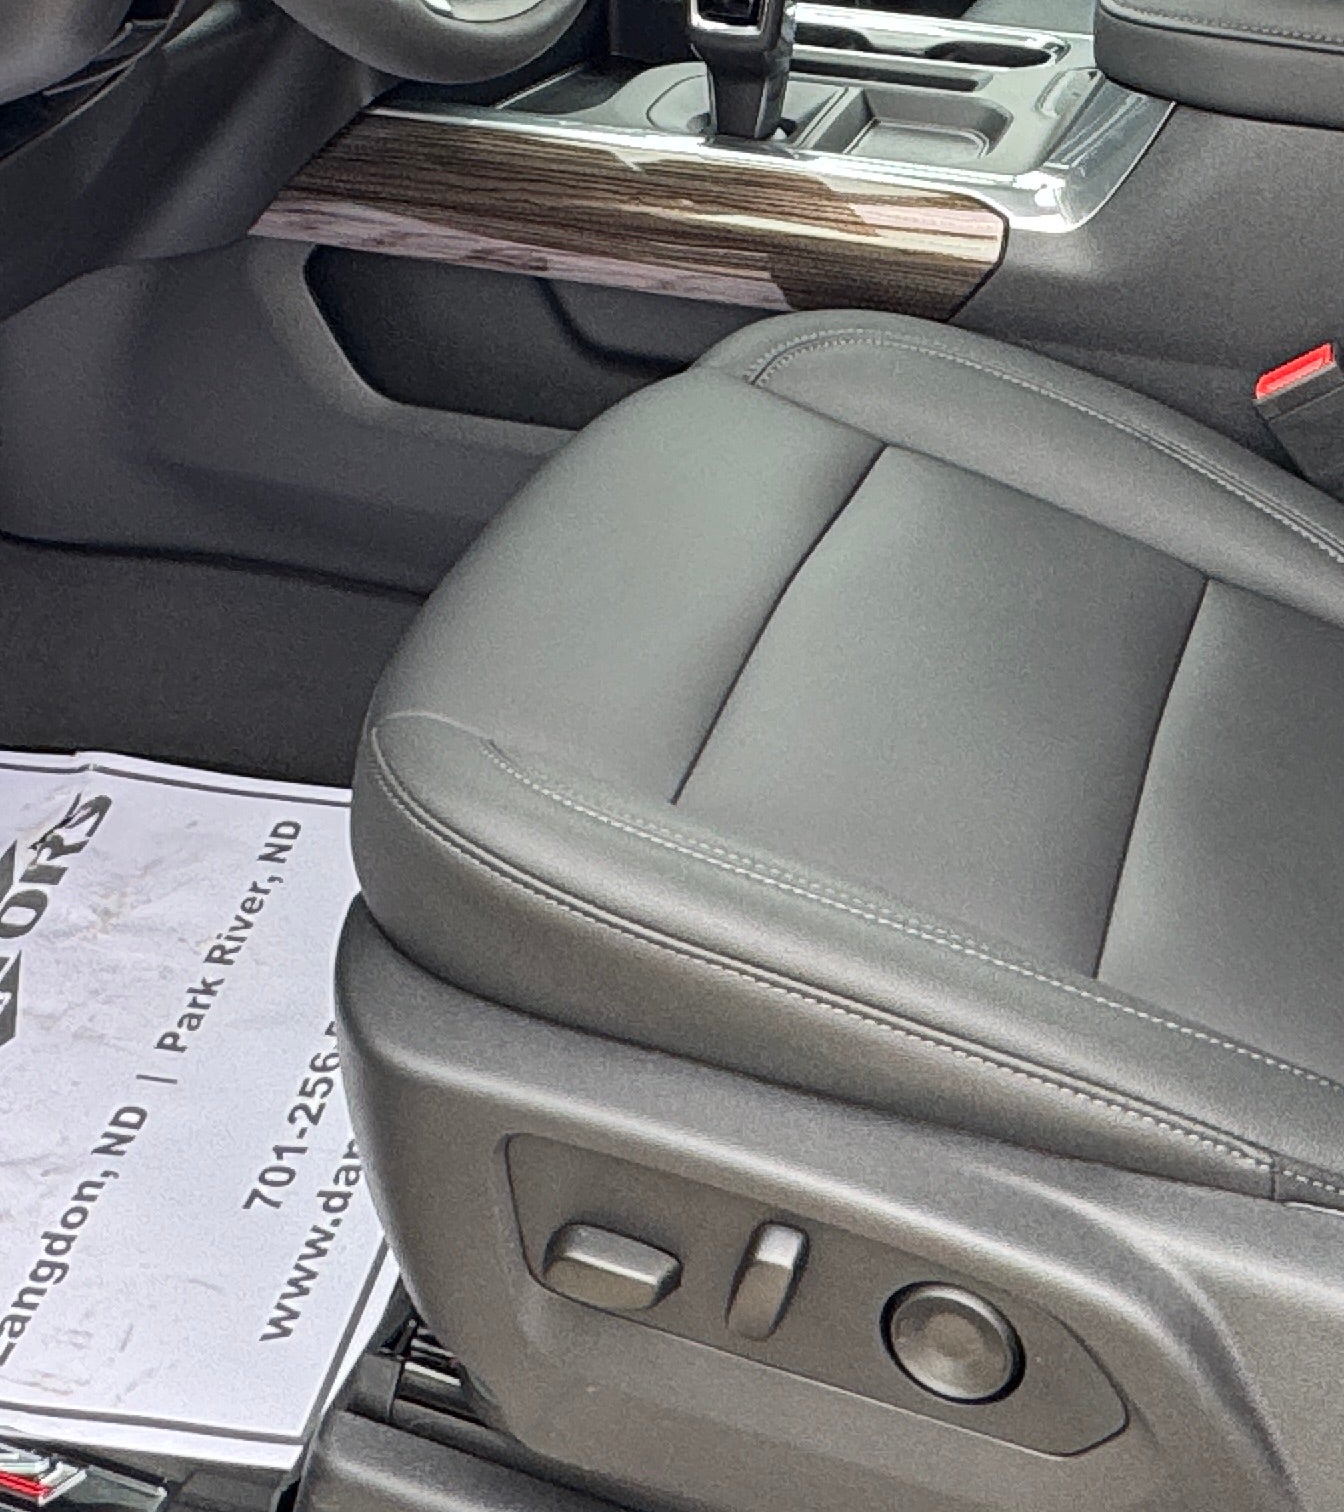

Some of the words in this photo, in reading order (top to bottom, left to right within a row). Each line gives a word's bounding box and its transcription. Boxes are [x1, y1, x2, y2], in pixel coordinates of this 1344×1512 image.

[91, 1104, 148, 1157] ND
[154, 973, 225, 1053] Park
[204, 874, 284, 966] River,
[258, 819, 302, 866] ND
